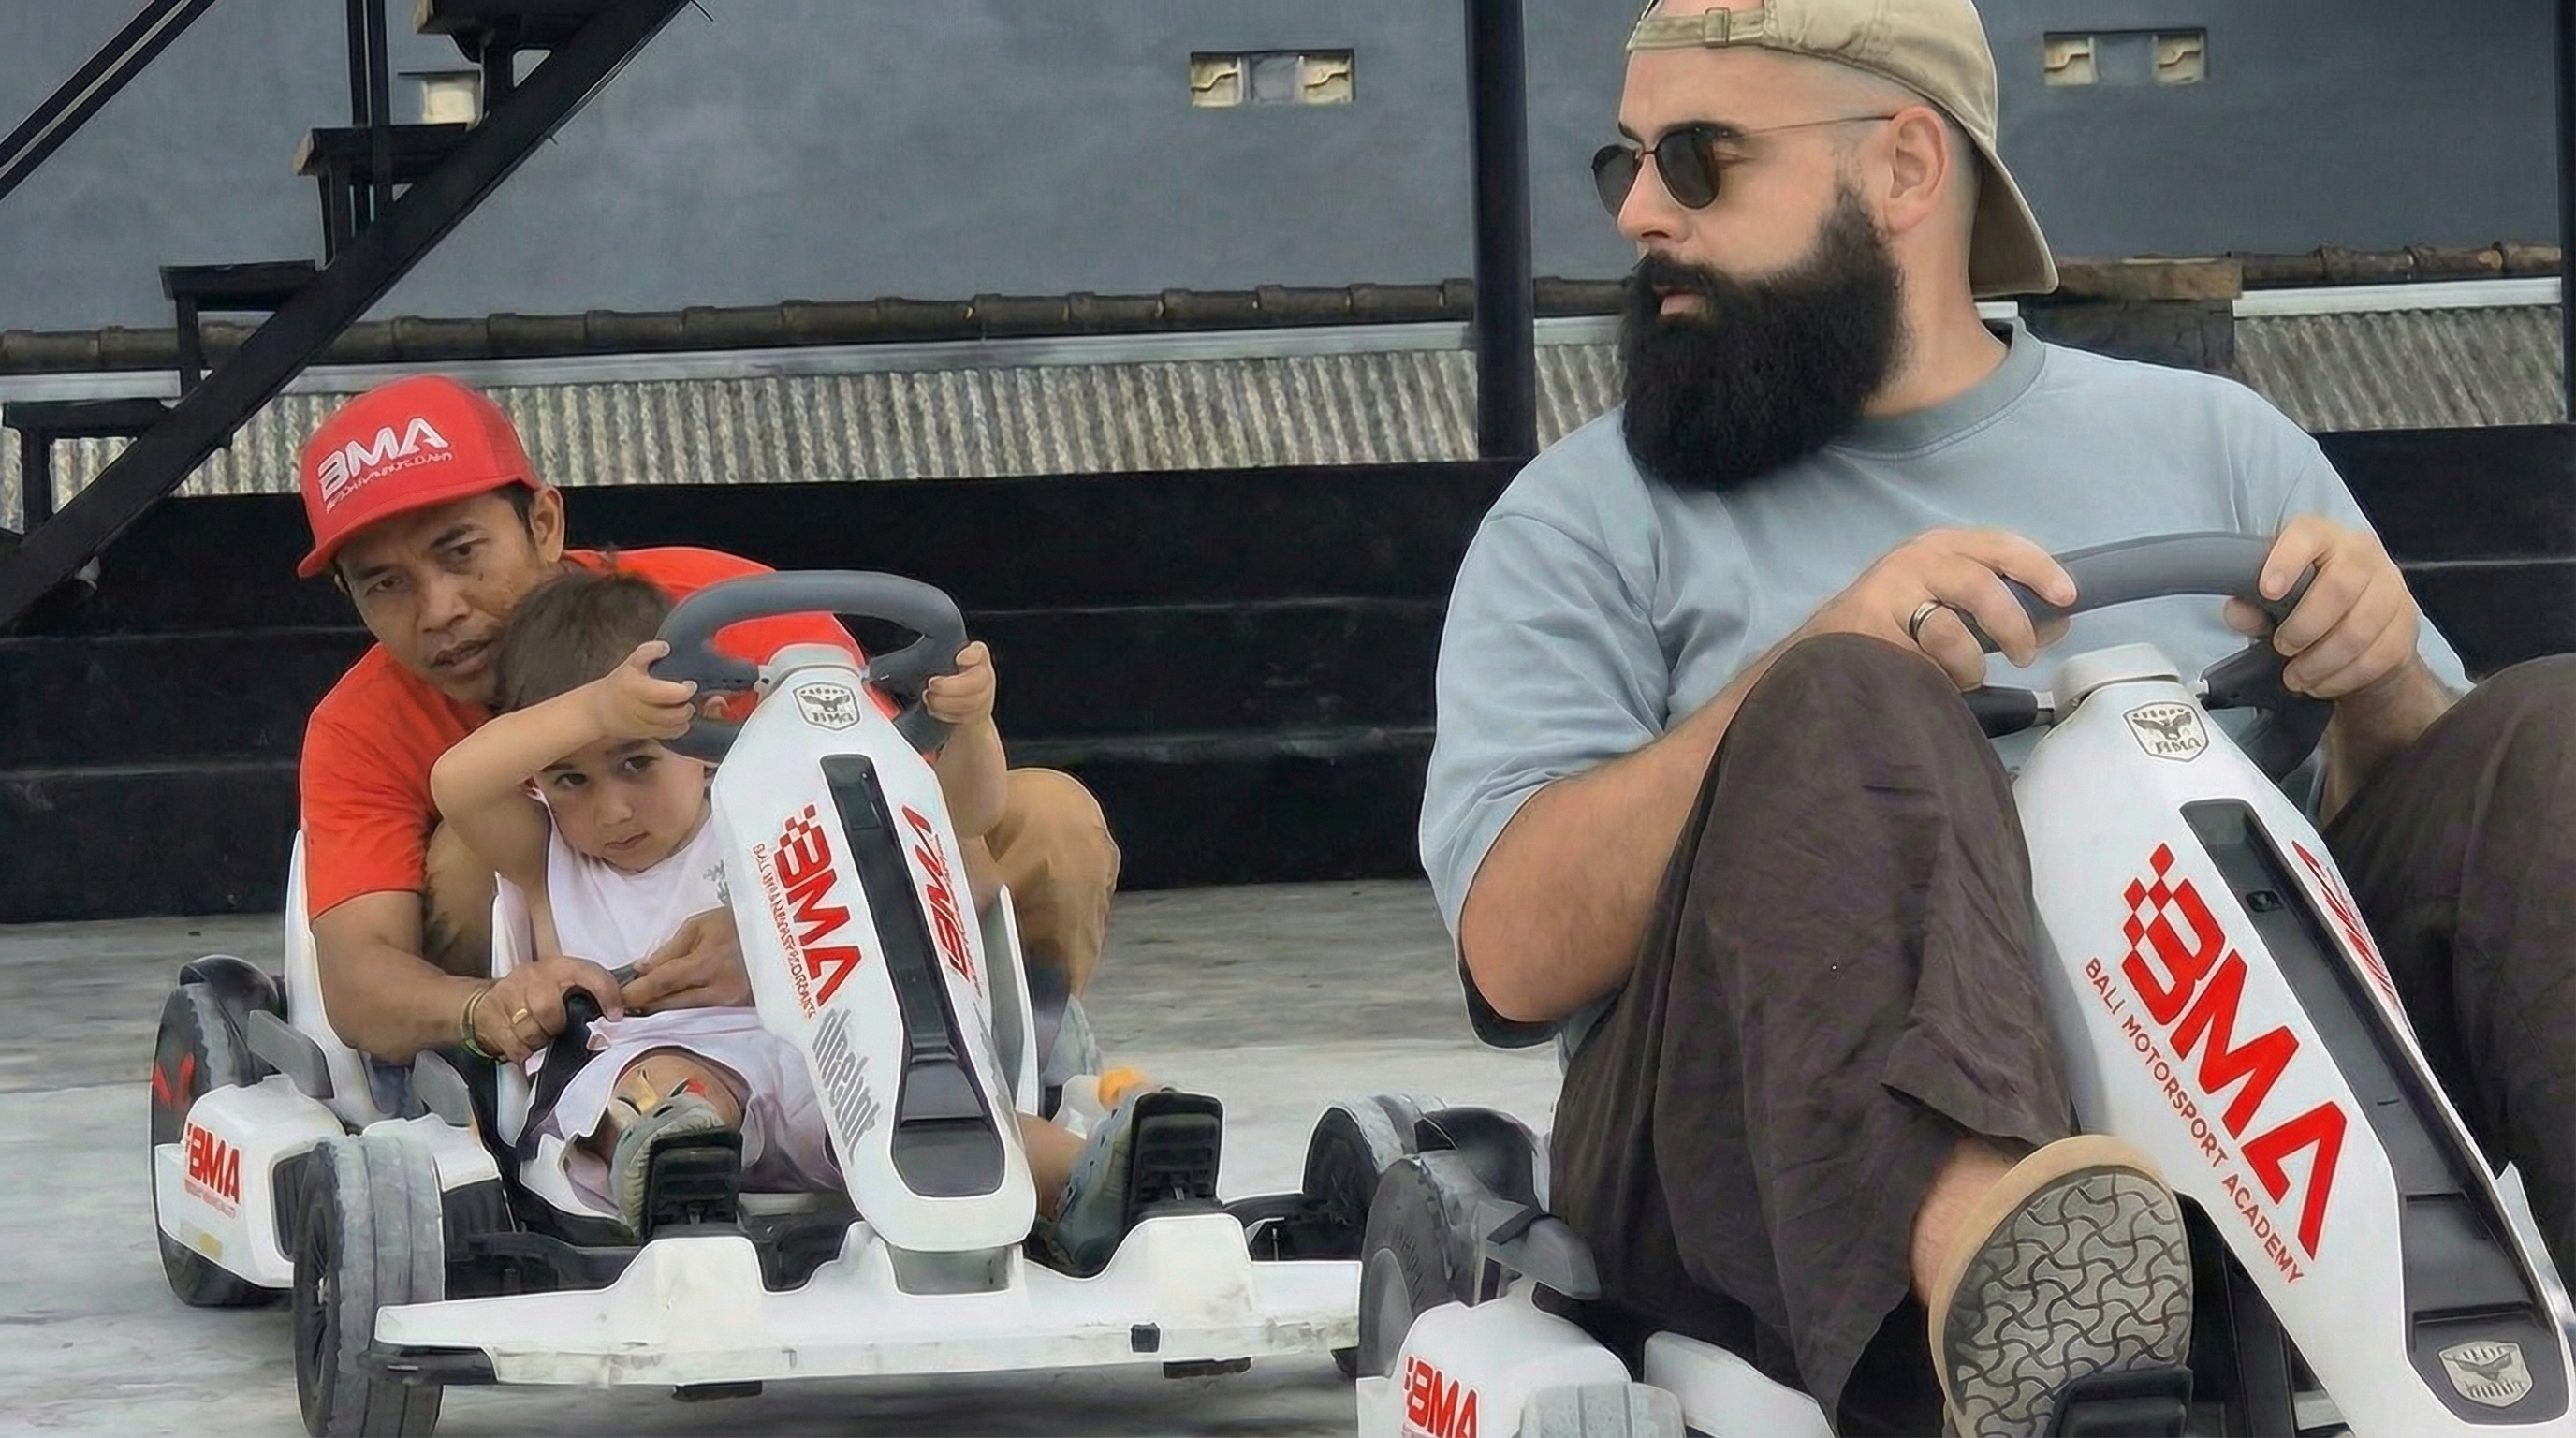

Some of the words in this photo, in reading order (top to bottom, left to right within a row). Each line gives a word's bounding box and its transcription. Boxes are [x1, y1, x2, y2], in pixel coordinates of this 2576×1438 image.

[318, 418, 450, 502] BMA
[774, 803, 862, 1008] BMA
[2085, 957, 2126, 1015] BALI
[2121, 1014, 2229, 1168] MOTORSPORT
[2221, 1173, 2305, 1284] ACADEMY
[2122, 843, 2348, 1261] BMA
[186, 1123, 241, 1204] BMA
[1404, 1355, 1478, 1438] BMA
